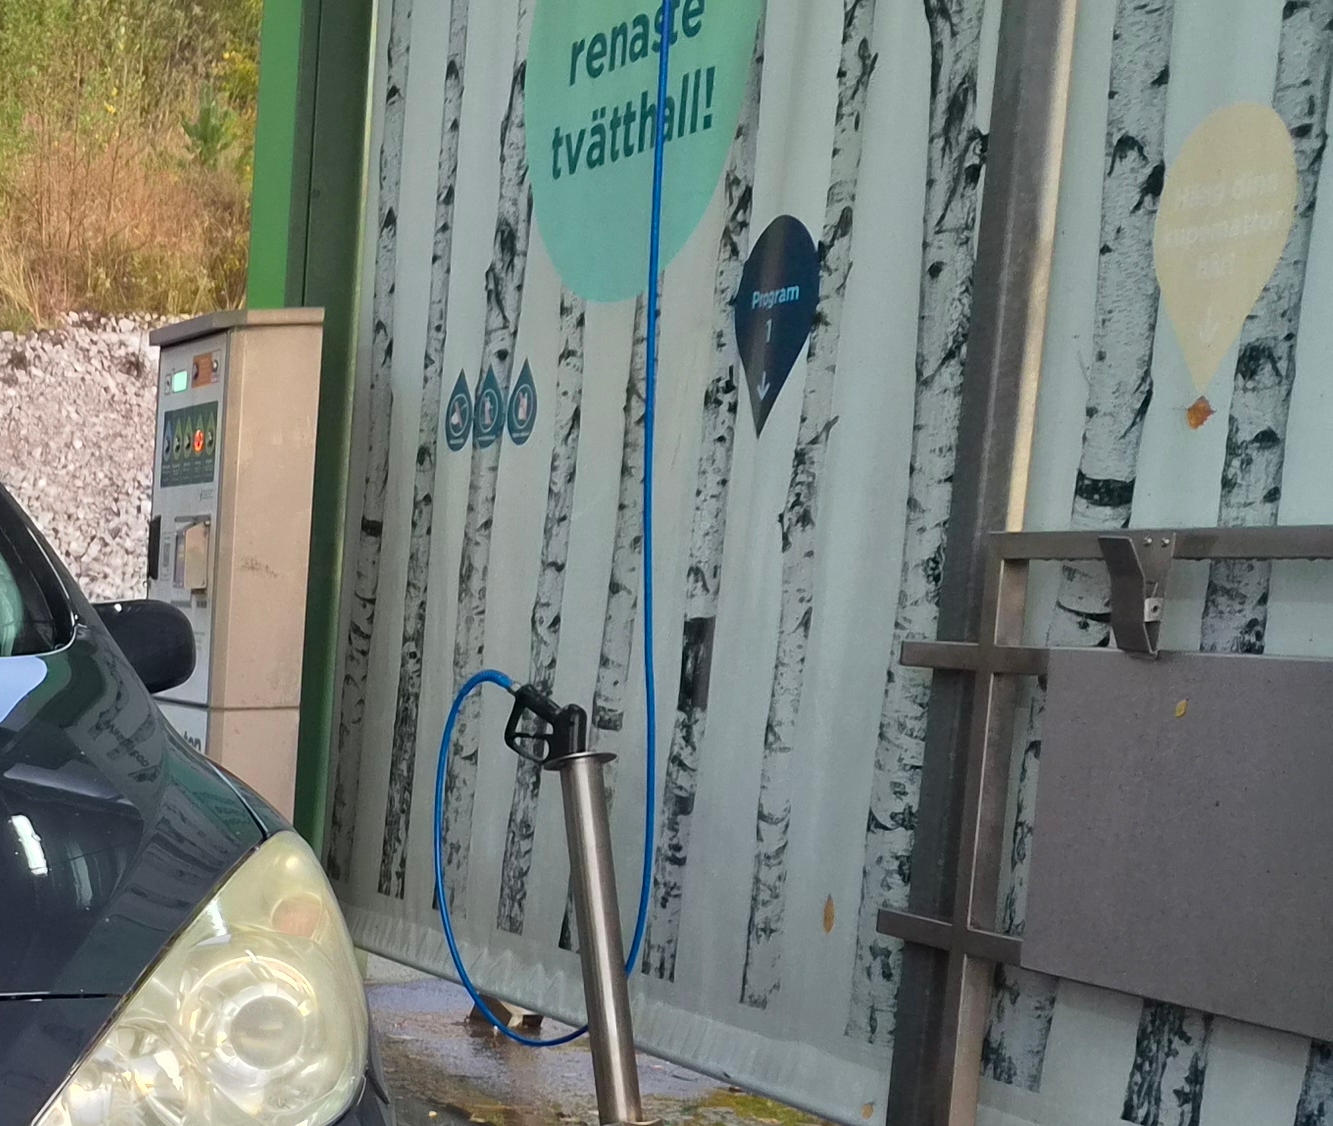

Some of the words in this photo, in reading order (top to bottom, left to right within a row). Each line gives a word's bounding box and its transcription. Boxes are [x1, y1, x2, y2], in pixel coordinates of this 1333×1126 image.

[552, 66, 715, 180] tvätthall!
[752, 284, 800, 310] Program
[765, 318, 773, 344] 1
